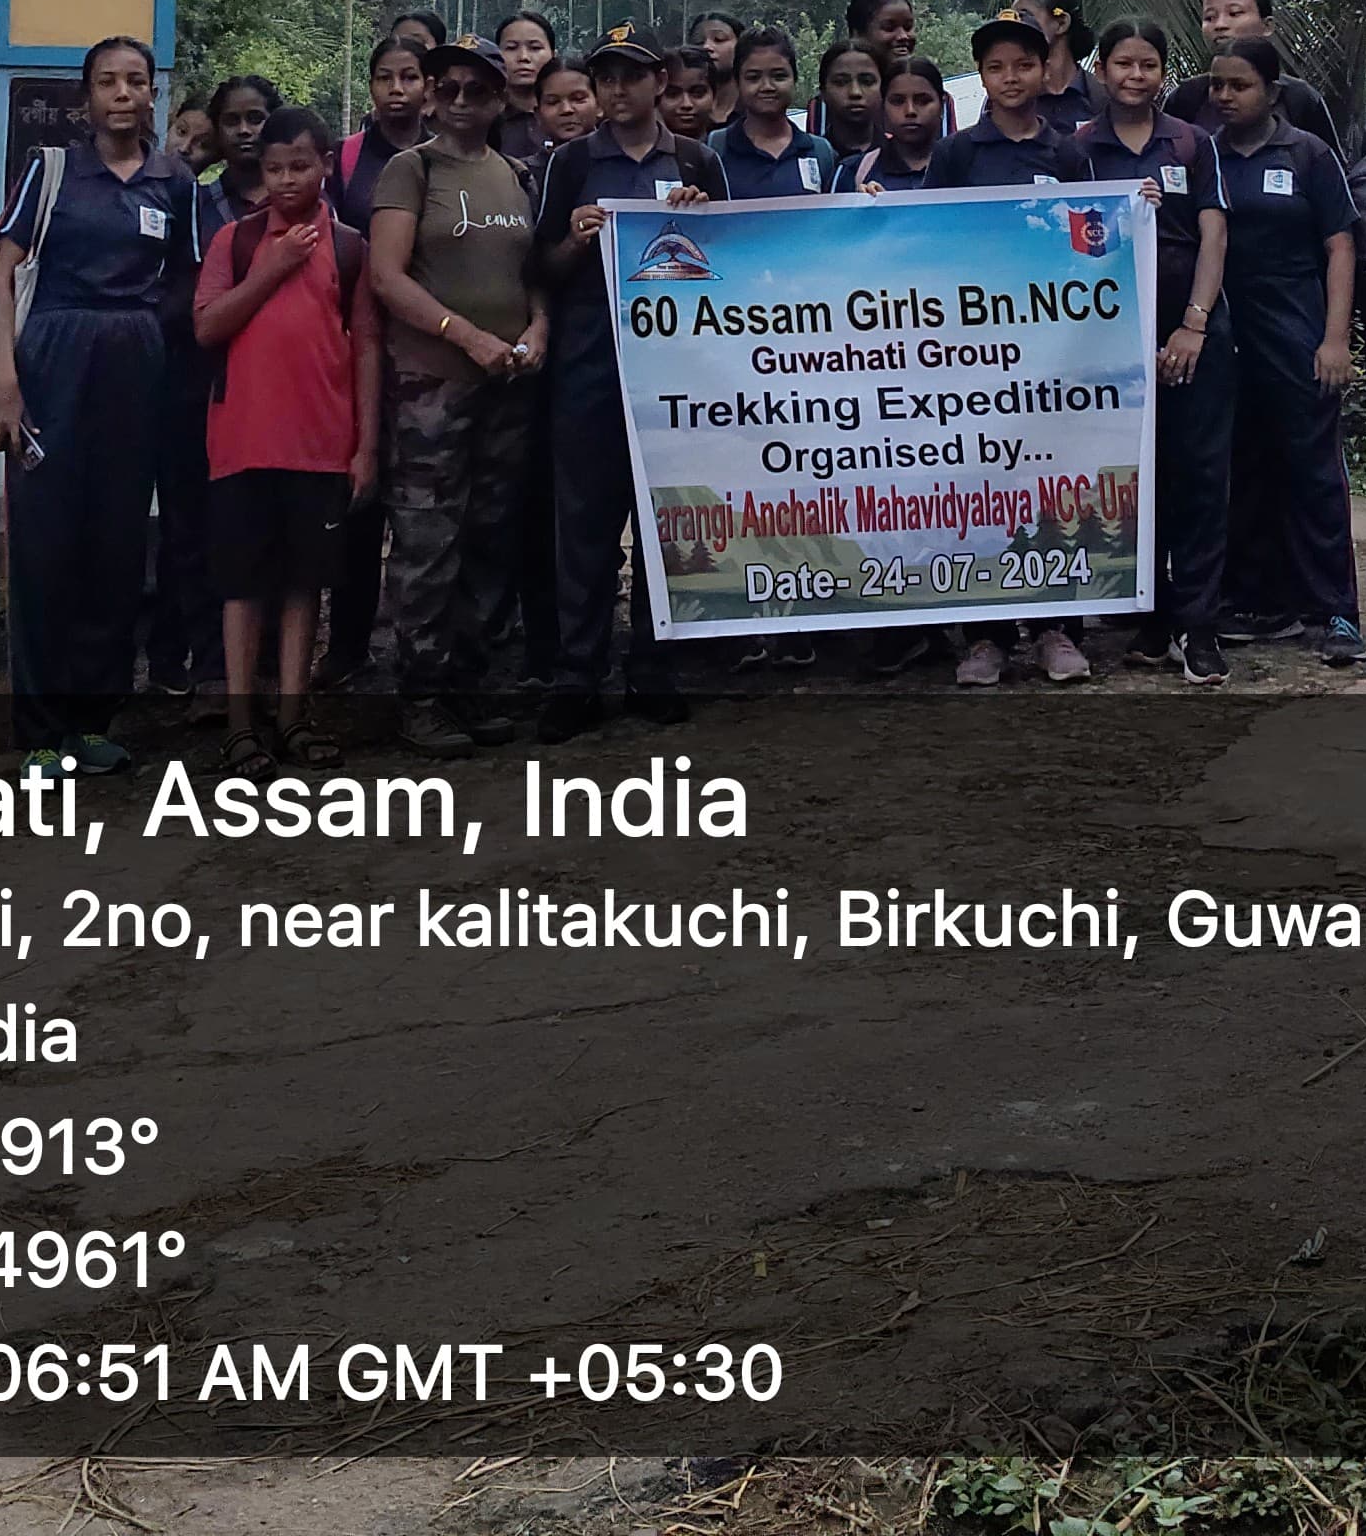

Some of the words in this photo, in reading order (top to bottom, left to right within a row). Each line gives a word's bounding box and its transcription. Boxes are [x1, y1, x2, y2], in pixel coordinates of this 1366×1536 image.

[629, 295, 678, 338] 60
[692, 295, 833, 336] Assam
[845, 288, 946, 332] Girls
[957, 278, 1121, 327] Bn.NCC
[751, 341, 907, 375] Guwahati
[917, 339, 1021, 372] Group
[658, 390, 861, 431] Trekking
[876, 378, 1120, 426] Expedition
[761, 433, 965, 480] Organised
[977, 432, 1053, 471] by...
[651, 492, 734, 553] arangi
[741, 486, 850, 538] Anchalik
[854, 479, 1033, 541] Mahavidyalaya
[1037, 474, 1093, 523] NCC
[1097, 471, 1139, 523] Uni
[745, 562, 851, 604] Date-
[859, 556, 922, 597] 24-
[929, 551, 992, 593] 07-
[999, 547, 1092, 590] 2024
